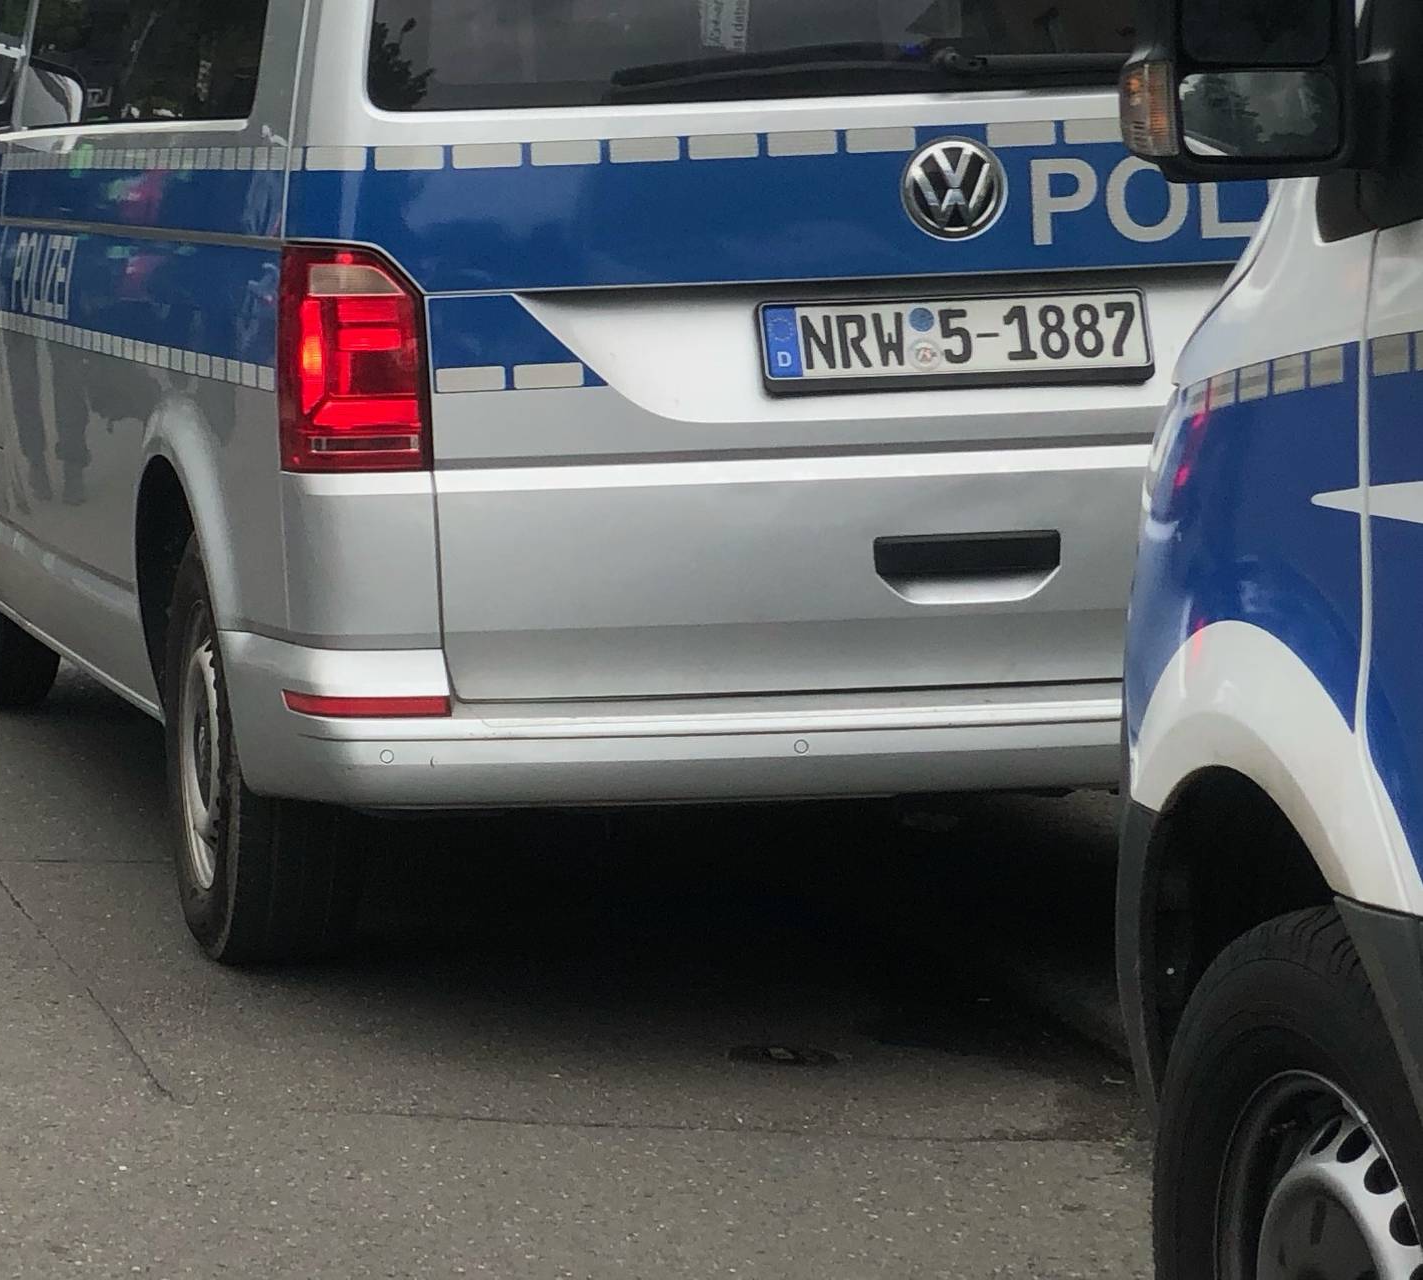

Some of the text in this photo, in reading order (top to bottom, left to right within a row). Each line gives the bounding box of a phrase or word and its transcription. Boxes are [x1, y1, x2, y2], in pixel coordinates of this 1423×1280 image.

[1030, 155, 1275, 246] POL
[11, 232, 79, 320] POLIZEI
[777, 351, 792, 367] D
[800, 301, 1136, 370] NRW 5-1887
